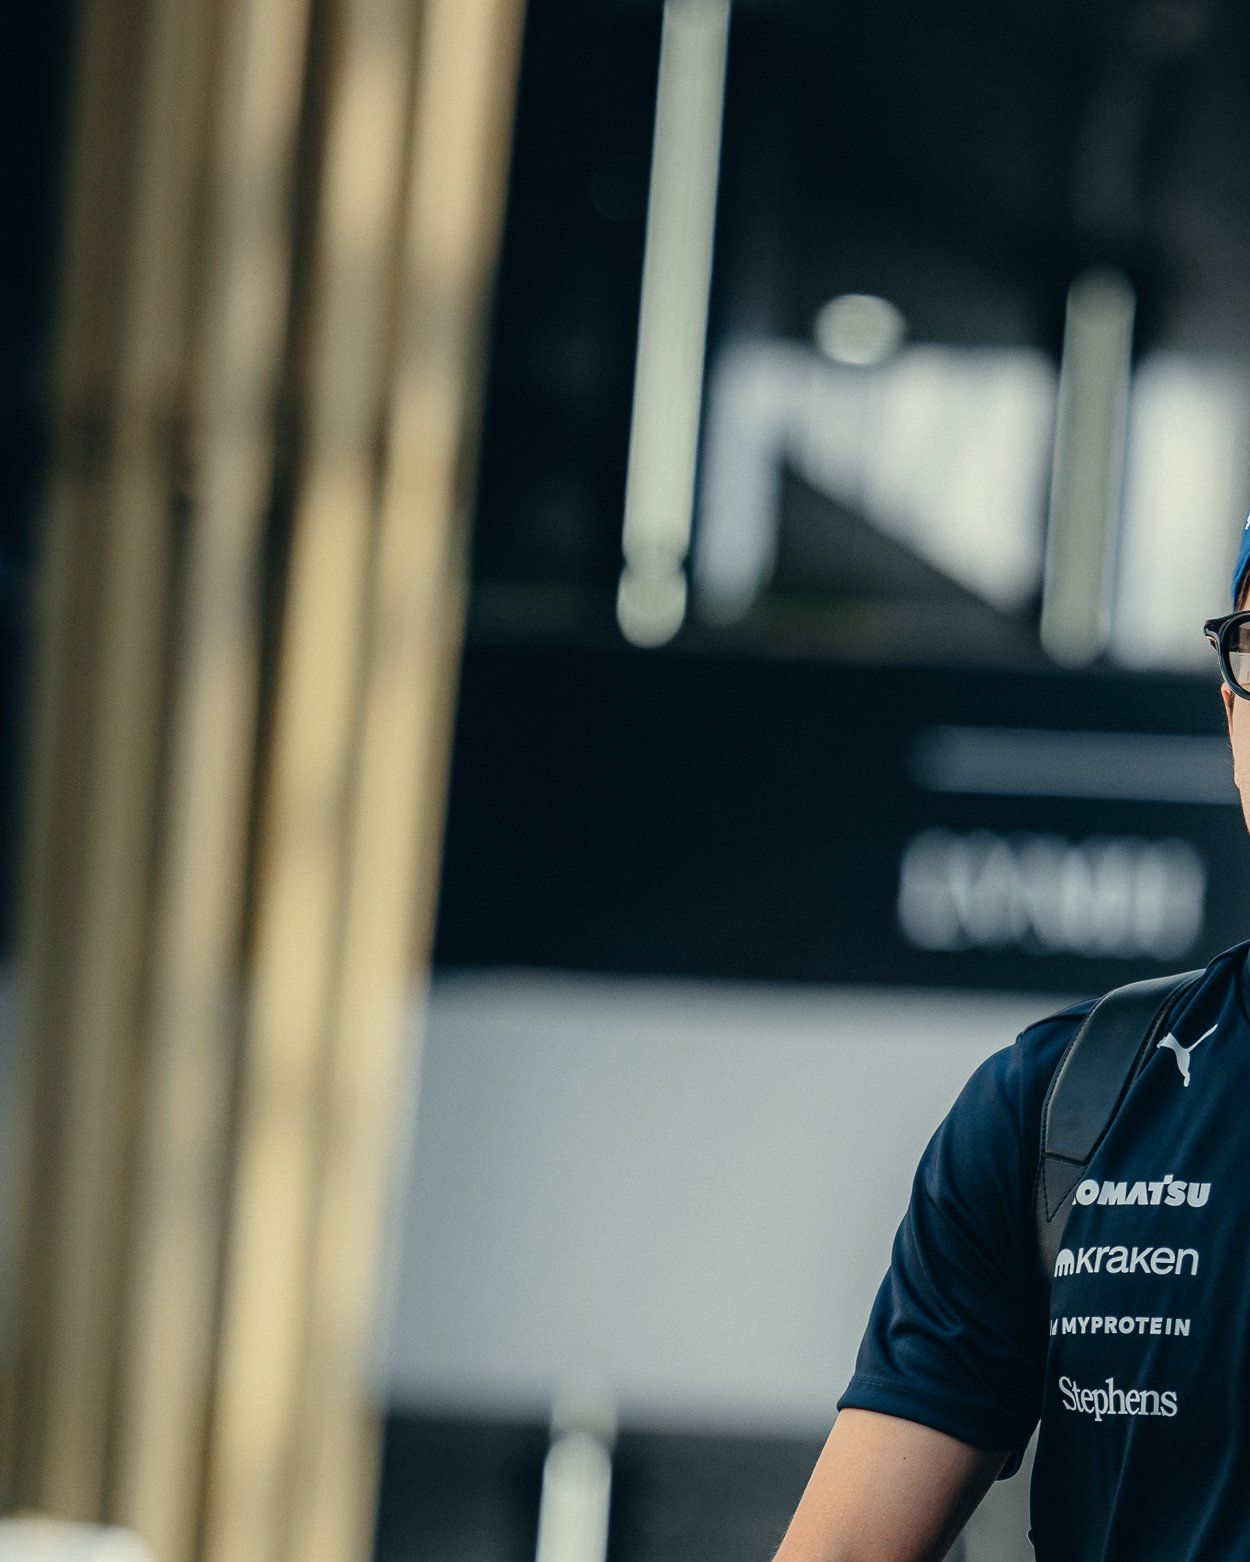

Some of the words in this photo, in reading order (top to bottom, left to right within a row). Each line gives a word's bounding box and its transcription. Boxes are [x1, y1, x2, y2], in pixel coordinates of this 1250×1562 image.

[1072, 1174, 1212, 1208] OMATSU
[1075, 1245, 1200, 1276] kraken
[1061, 1316, 1192, 1337] MYPROTEIN
[1058, 1375, 1179, 1422] Stephens
